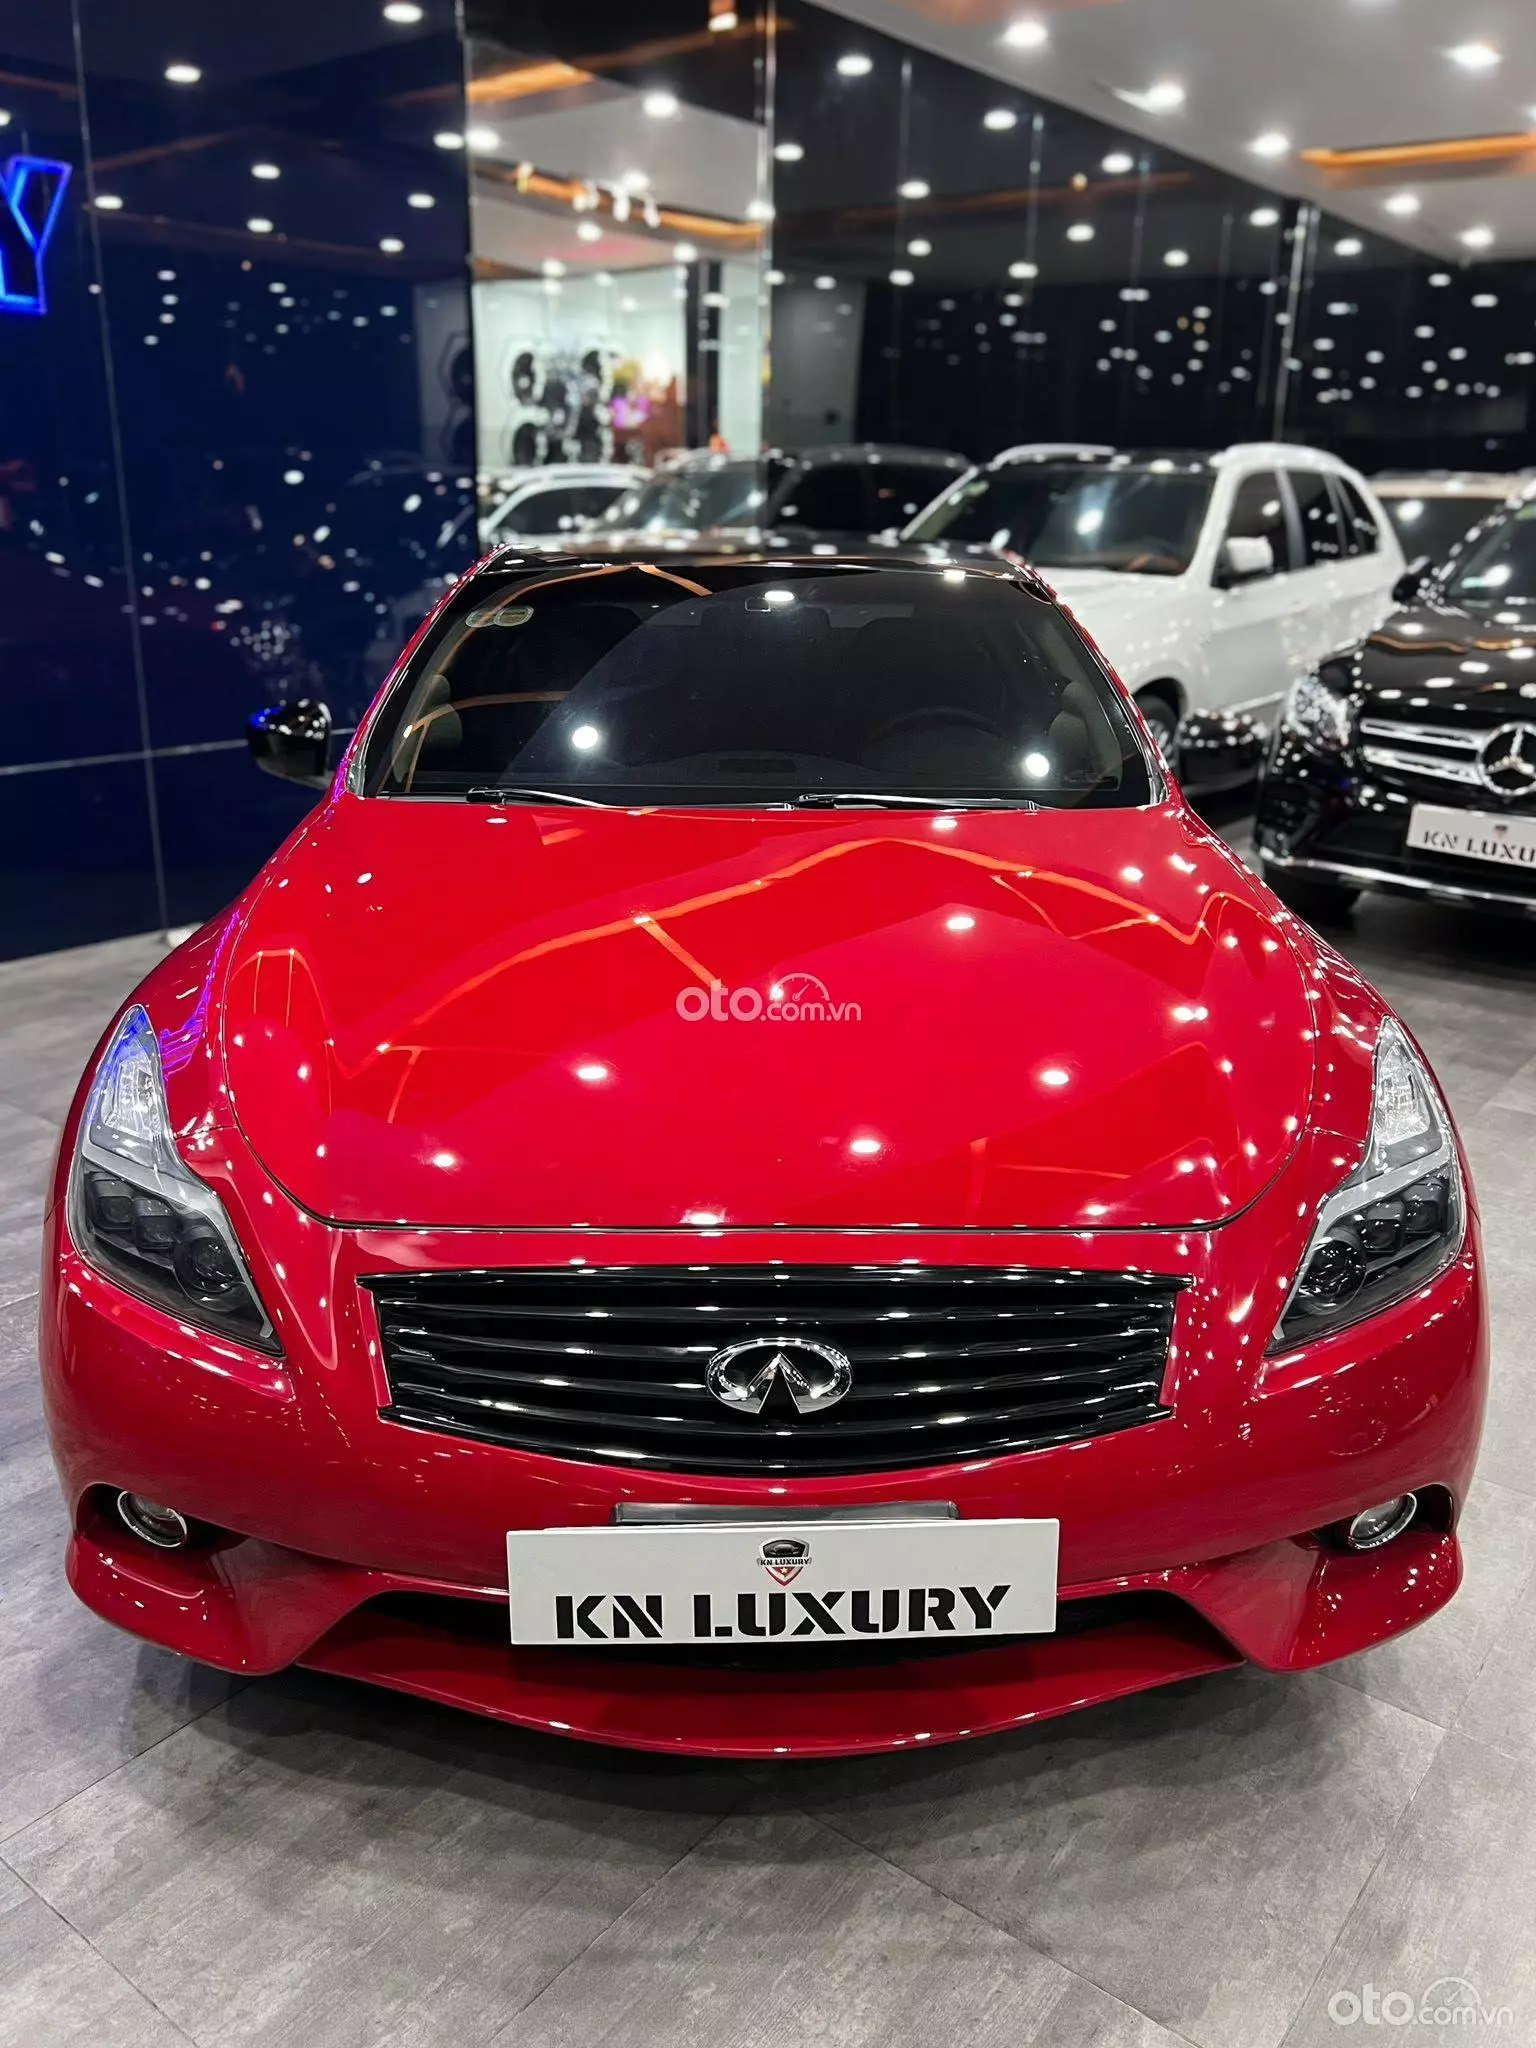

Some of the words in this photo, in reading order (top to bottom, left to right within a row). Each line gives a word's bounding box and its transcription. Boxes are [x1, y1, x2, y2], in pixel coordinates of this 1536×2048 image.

[1424, 830, 1459, 849] KN
[556, 1594, 663, 1639] KN
[693, 1585, 1012, 1637] LUXURY
